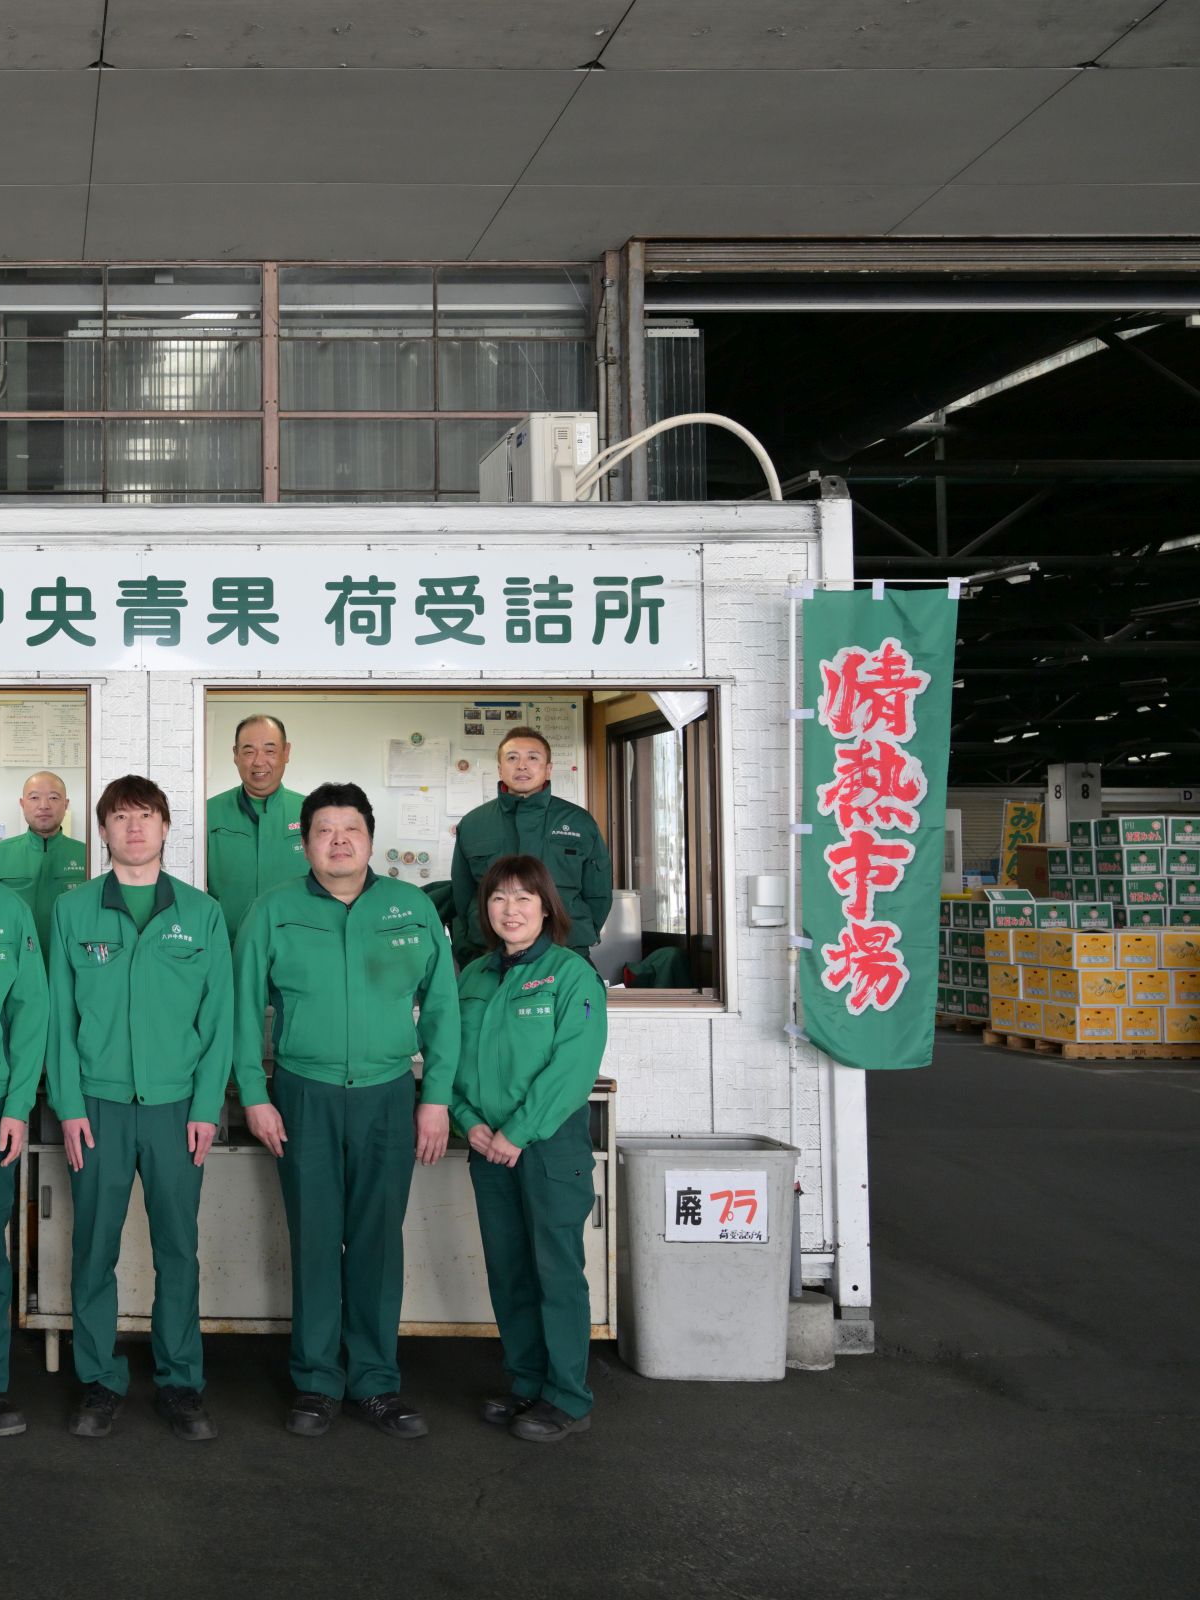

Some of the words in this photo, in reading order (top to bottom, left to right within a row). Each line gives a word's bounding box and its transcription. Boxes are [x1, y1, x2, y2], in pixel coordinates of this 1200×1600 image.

[325, 575, 665, 646] 荷受詰所
[1055, 785, 1062, 799] 8
[1081, 784, 1090, 799] 8
[1183, 790, 1193, 801] D
[820, 640, 926, 1012] 情熱市場
[675, 1187, 702, 1226] 廃
[710, 1189, 758, 1225] プラ
